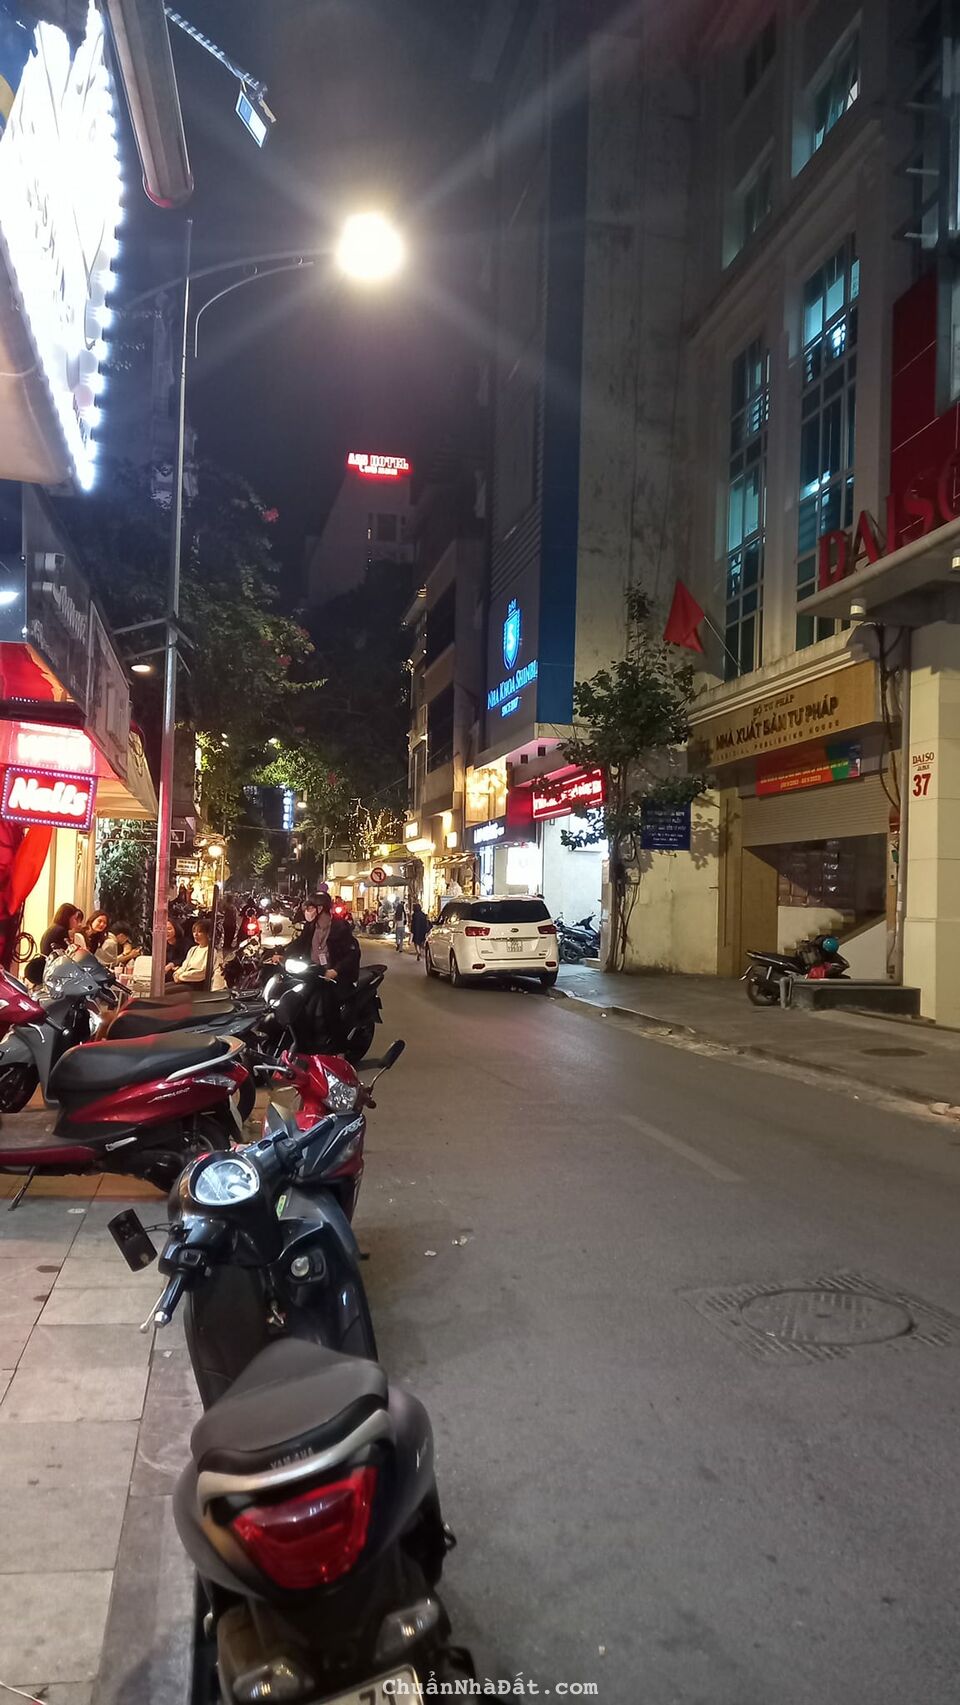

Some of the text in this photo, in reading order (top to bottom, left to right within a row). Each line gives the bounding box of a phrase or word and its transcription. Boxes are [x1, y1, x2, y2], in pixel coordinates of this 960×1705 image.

[370, 455, 409, 470] HOTEL
[775, 694, 795, 708] PHÁP
[736, 717, 763, 743] XUẤT
[805, 694, 839, 723] PHÁP
[809, 719, 840, 734] HOUSE
[912, 752, 934, 764] DAISO
[912, 773, 931, 796] 37
[8, 777, 88, 816] Nails
[270, 1446, 314, 1469] YAMAHA
